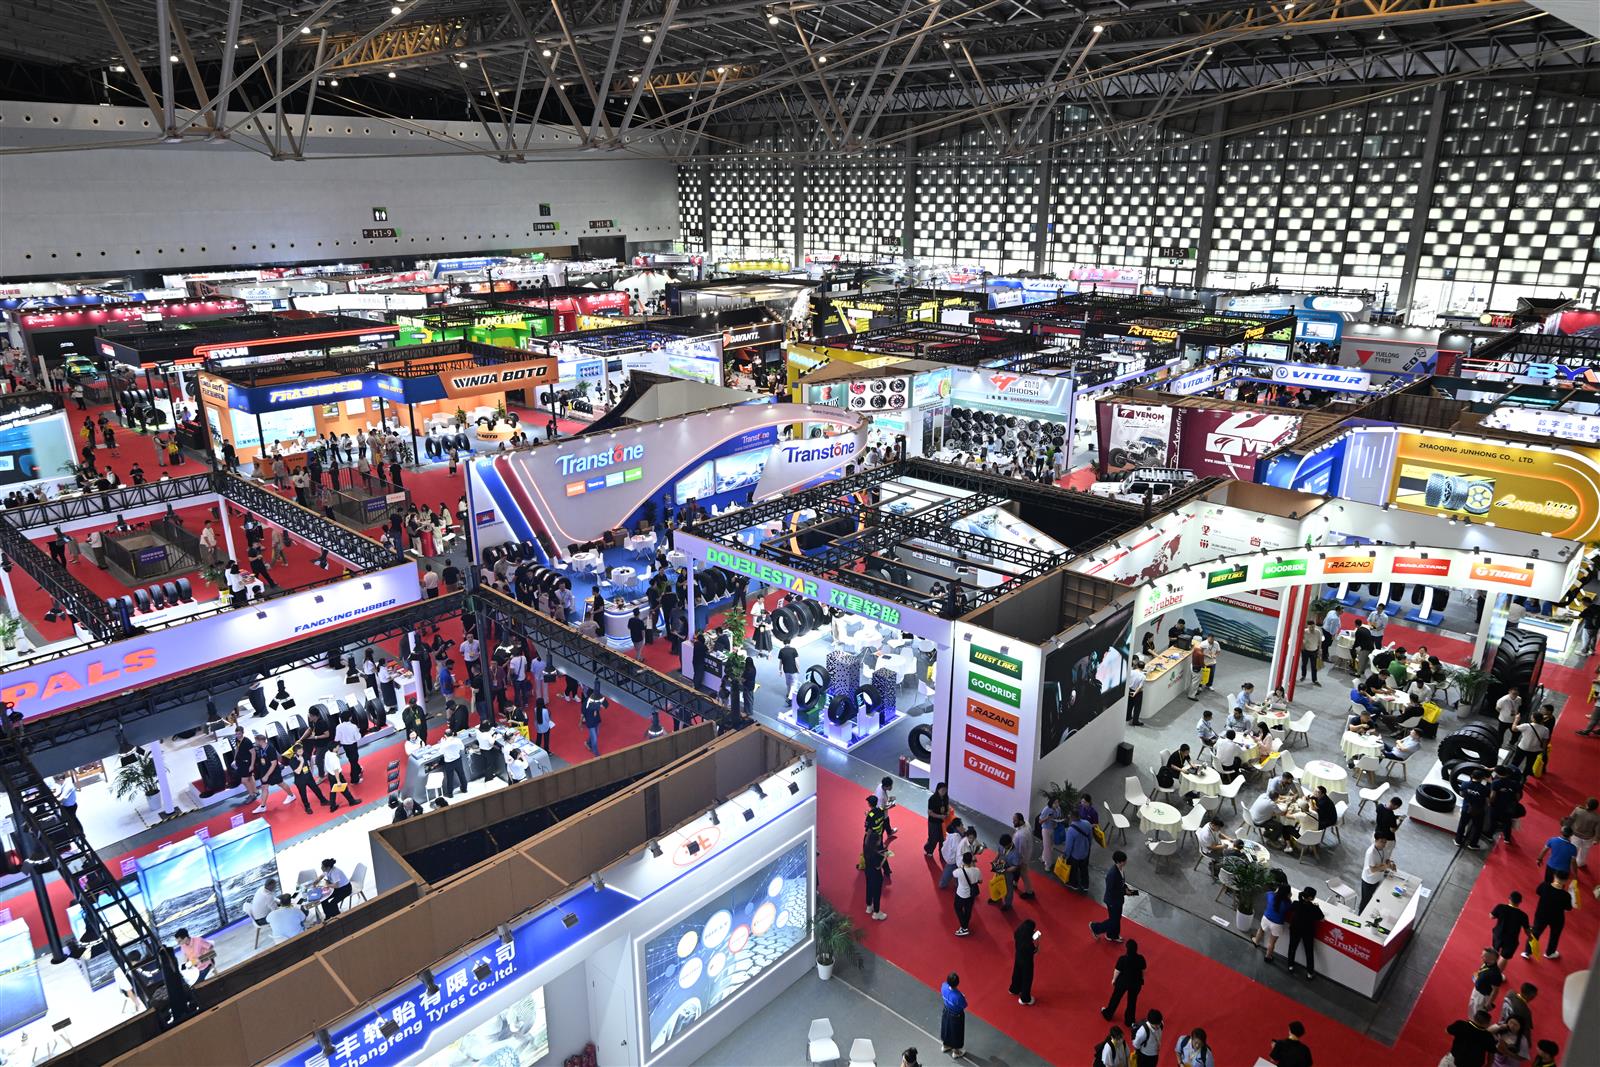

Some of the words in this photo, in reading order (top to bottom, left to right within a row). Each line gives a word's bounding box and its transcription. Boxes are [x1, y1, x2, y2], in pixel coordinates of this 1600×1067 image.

[372, 229, 392, 238] H1-9
[1163, 248, 1184, 257] H1-5
[475, 316, 501, 327] LONG
[502, 313, 523, 326] WAY
[1375, 351, 1400, 359] YUELONG
[453, 373, 498, 389] WINDA
[501, 366, 548, 382] BOTO
[1182, 374, 1211, 389] VITOUR
[1292, 370, 1363, 385] VITOUR
[1135, 410, 1165, 421] VENOM
[555, 443, 644, 476] Transtone
[782, 441, 855, 463] Transtone
[1418, 443, 1458, 453] ZHAOQING
[1460, 448, 1497, 459] JUNHONG
[1518, 456, 1535, 465] LTD.
[706, 547, 819, 597] DOUBLESTAR
[1264, 563, 1303, 574] GOODRIDE
[1327, 561, 1370, 569] TRAZANO
[294, 610, 353, 633] FANGXING
[353, 598, 396, 615] RUBBER
[829, 588, 899, 625] 双星轮胎
[1228, 600, 1264, 612] INTRODUCTION
[974, 651, 997, 664] WEST
[996, 659, 1017, 672] LAKE
[971, 678, 1017, 701] GOODRIDE
[970, 704, 1015, 727] TRAZANO
[979, 761, 1010, 781] TIANLI
[427, 994, 466, 1023] Tyres
